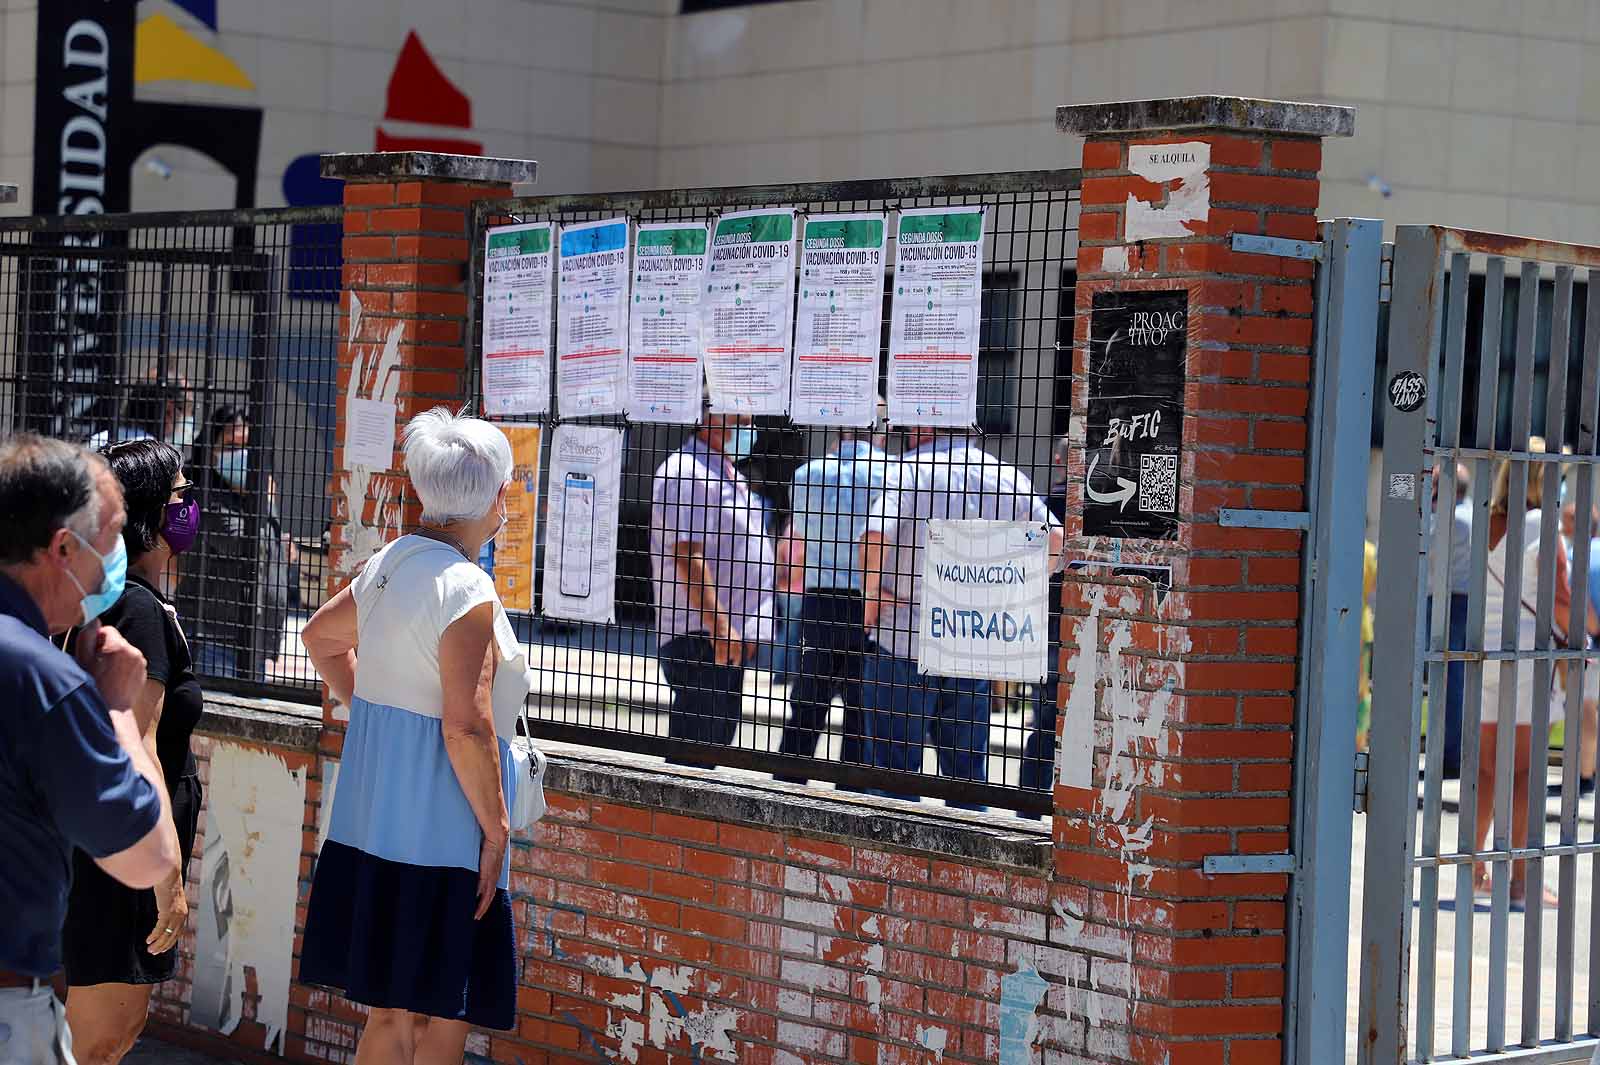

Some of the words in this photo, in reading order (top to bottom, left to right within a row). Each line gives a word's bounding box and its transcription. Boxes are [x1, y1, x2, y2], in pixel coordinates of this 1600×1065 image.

[1149, 154, 1159, 164] SE
[1160, 153, 1196, 165] ALQUILA
[715, 233, 735, 246] SEGUNDA
[736, 232, 752, 243] DOSIS
[806, 238, 829, 248] SEGUNDA
[829, 237, 845, 248] DOSIS
[900, 232, 926, 243] SEGUNDA
[926, 231, 943, 243] DOSIS
[638, 245, 660, 256] SEGUNDA
[660, 245, 673, 255] DOSIS
[712, 243, 751, 261] VACUNACIÓN
[752, 244, 789, 259] COVID-19
[805, 249, 845, 266] VACUNACIÓN
[845, 251, 880, 265] COVID-19
[900, 244, 943, 262] VACUNACIÓN
[944, 245, 977, 260] COVID-19
[488, 256, 520, 273] VACUNACIÓN
[521, 255, 548, 270] COVID-19
[561, 256, 596, 273] VACUNACIÓN
[596, 251, 625, 267] COVID-19
[637, 256, 673, 272] VACUNACIÓN
[673, 258, 704, 271] COVID-19
[1391, 377, 1422, 394] BASS
[1393, 391, 1419, 406] LAND
[1103, 409, 1161, 445] BuFIC
[936, 560, 1026, 585] VACUNACIÓN
[930, 607, 1034, 642] ENTRADA
